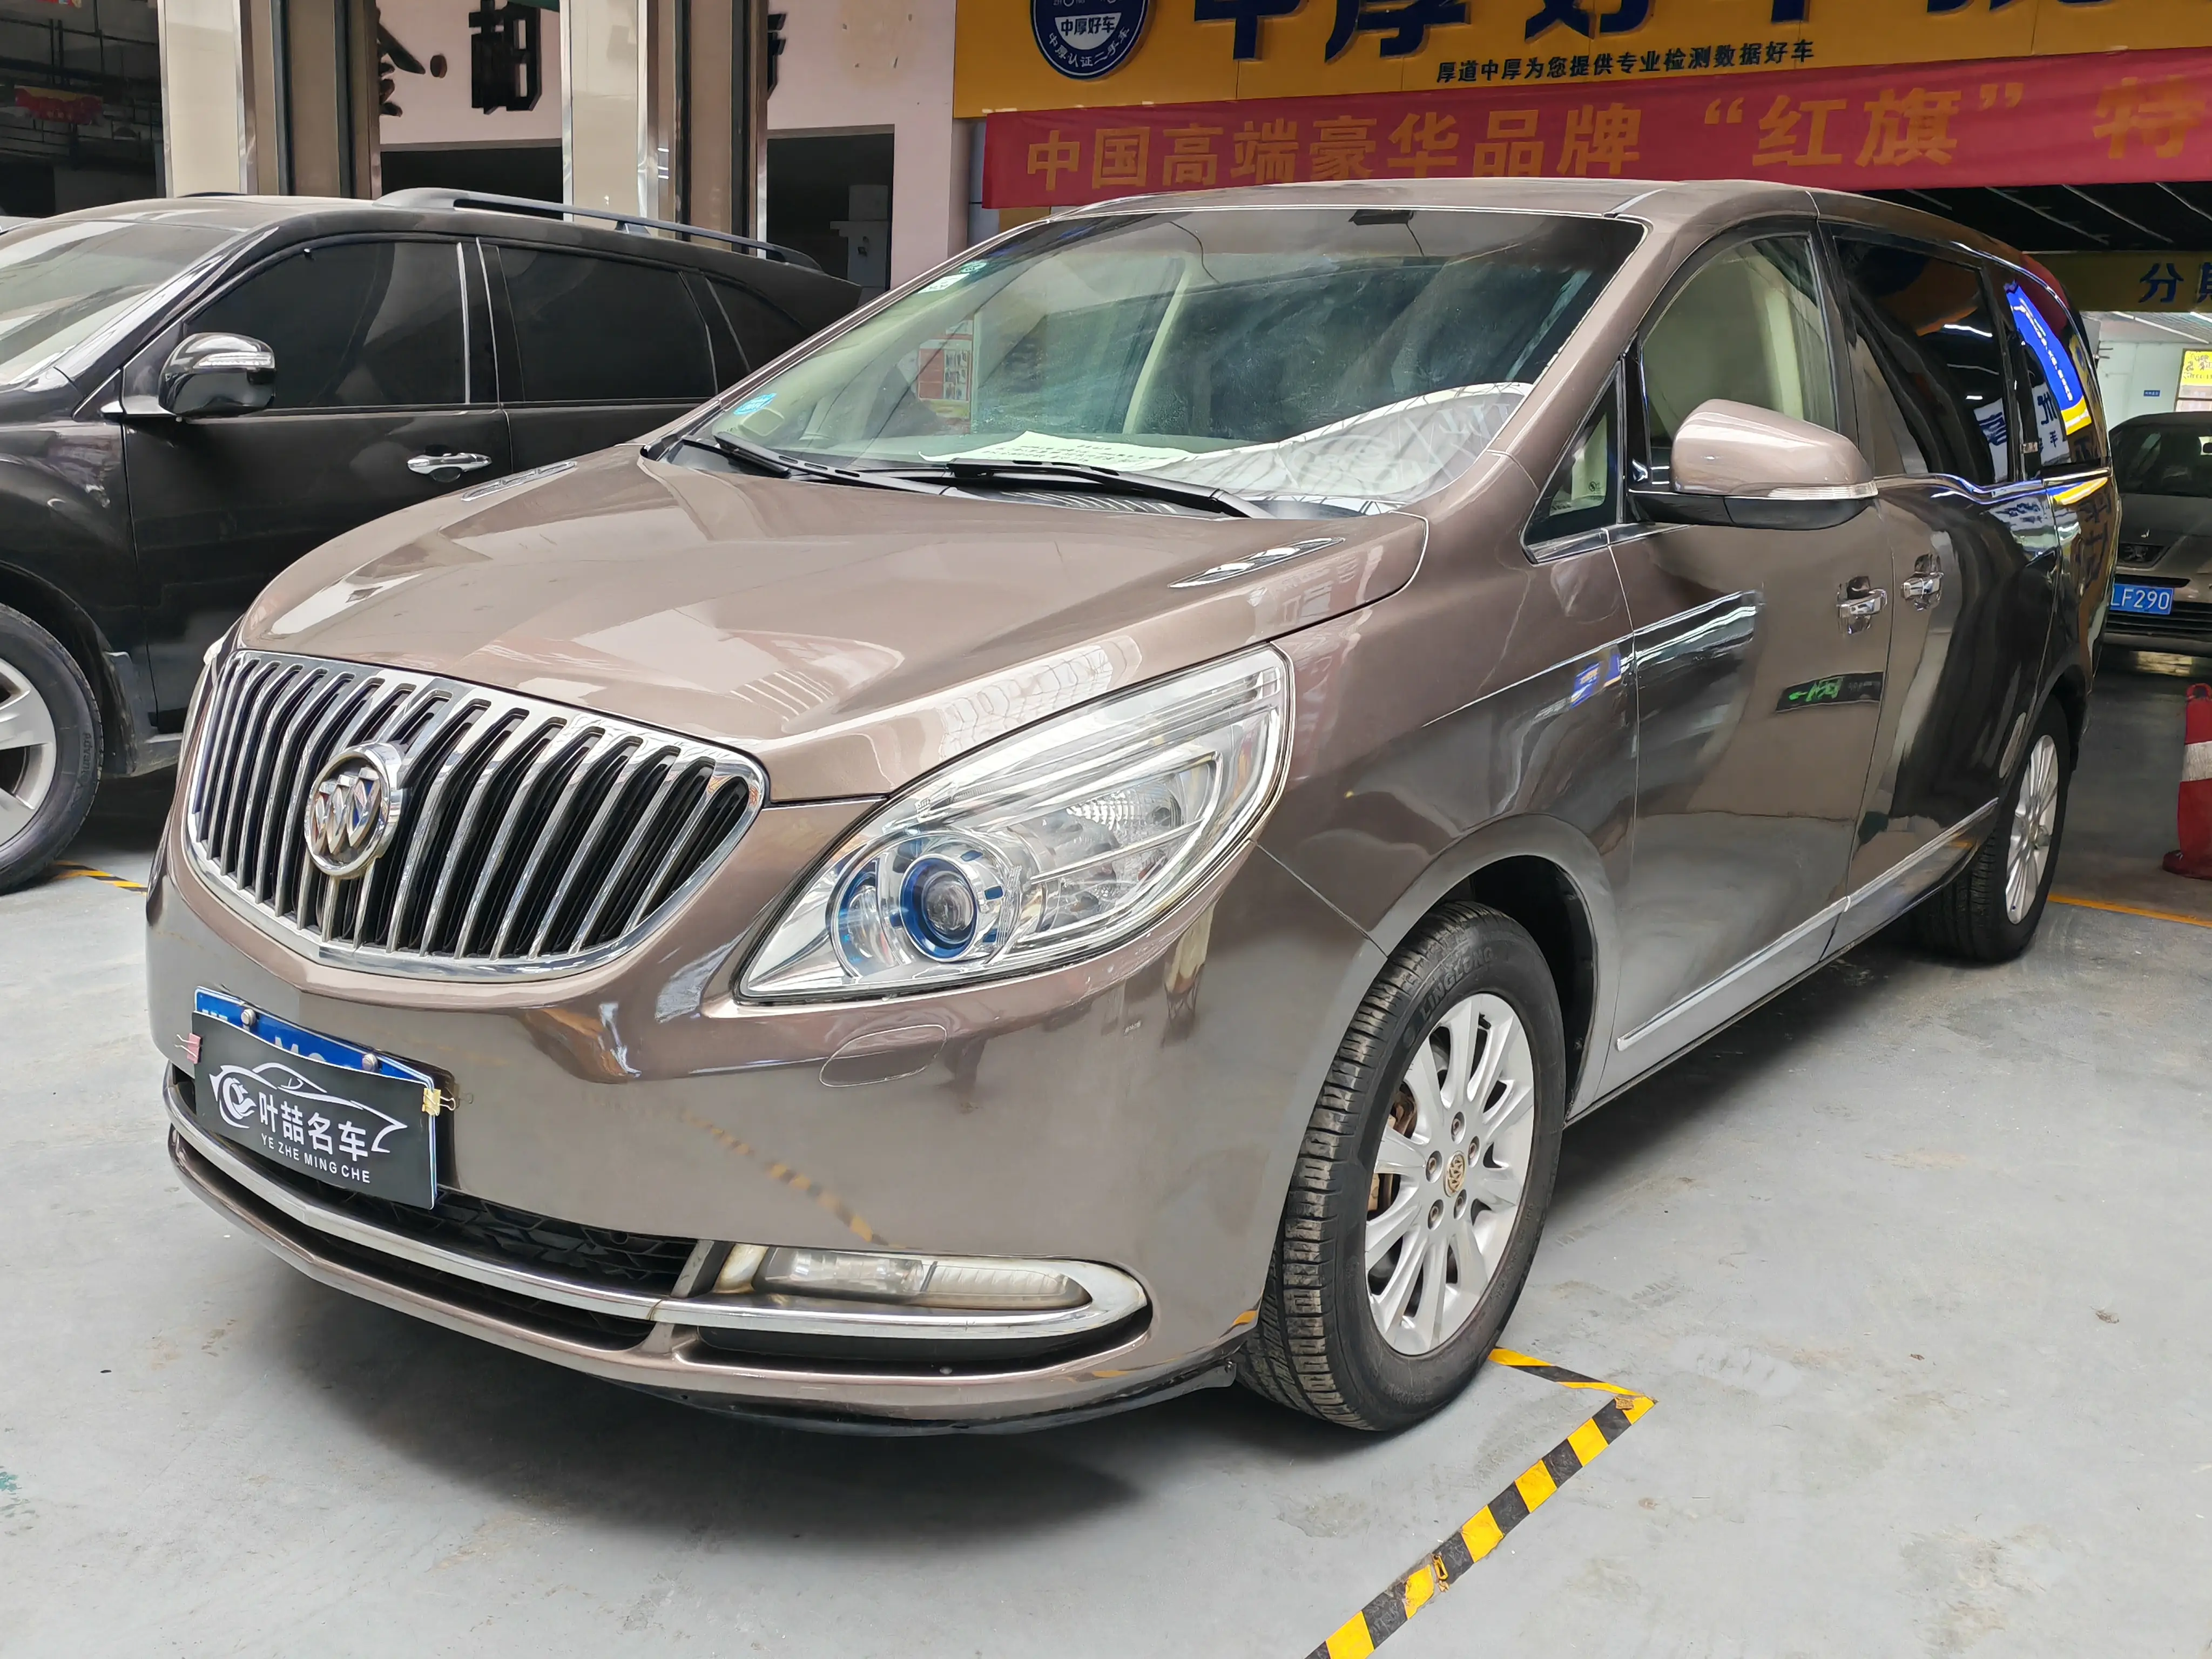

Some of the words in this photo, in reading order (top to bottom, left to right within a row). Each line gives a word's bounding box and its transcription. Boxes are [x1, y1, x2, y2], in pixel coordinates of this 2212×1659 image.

[1049, 26, 1130, 68] 中厚认证二手车
[1061, 16, 1116, 36] 中厚好车
[1437, 39, 1813, 83] 厚道中厚为您提供专业检测数据好车
[1027, 102, 1641, 191] 中国高端豪华品牌
[2092, 76, 2205, 159] 特
[259, 1092, 368, 1162] 叶喆名车
[261, 1133, 274, 1150] YE
[278, 1142, 299, 1161] ZHE
[304, 1152, 338, 1174] MING
[341, 1165, 370, 1183] CHE
